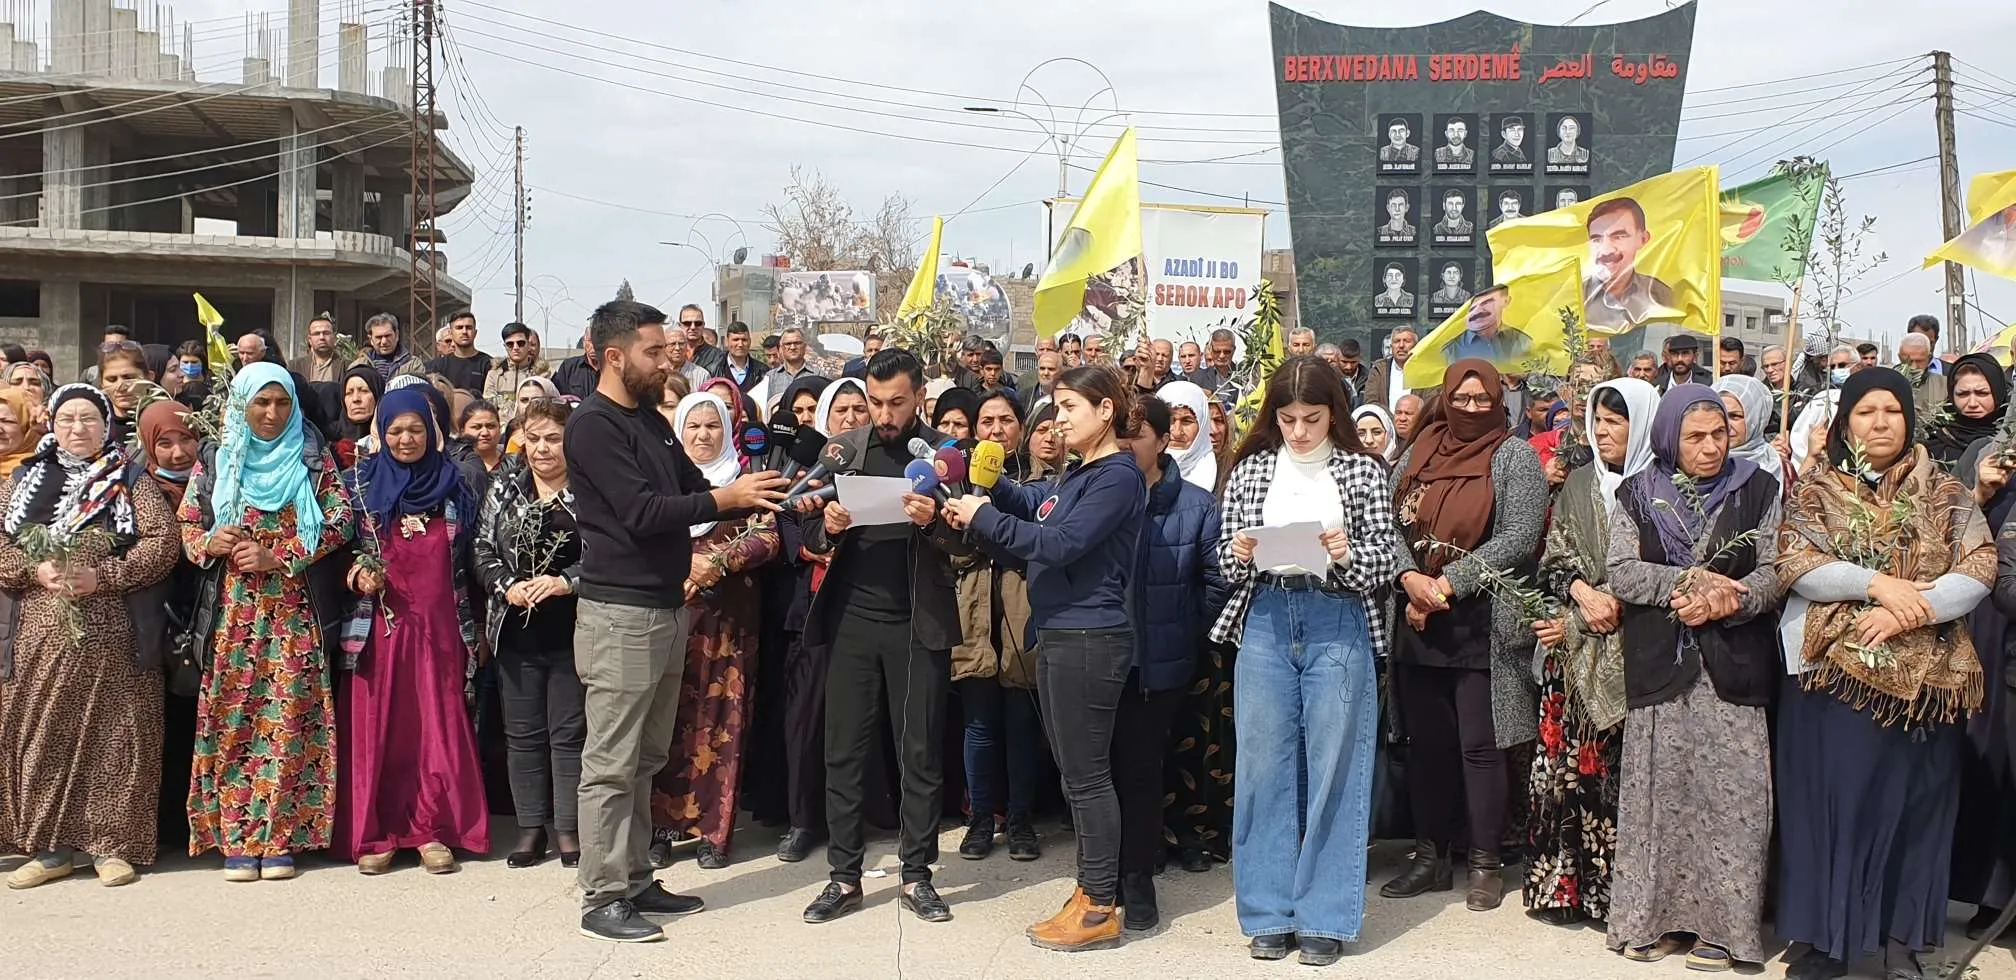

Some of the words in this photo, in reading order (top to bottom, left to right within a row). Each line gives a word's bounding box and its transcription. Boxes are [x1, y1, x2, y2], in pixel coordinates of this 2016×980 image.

[1284, 54, 1418, 82] BERXWEDANA
[1429, 42, 1521, 81] SERDEMÊ
[1538, 54, 1593, 84] العصر
[1611, 55, 1680, 85] مقاومة
[1164, 257, 1203, 278] AZADÎ
[1206, 260, 1216, 279] JI
[1220, 261, 1239, 280] BO
[1155, 283, 1209, 308] SEROK
[1212, 286, 1246, 310] APO
